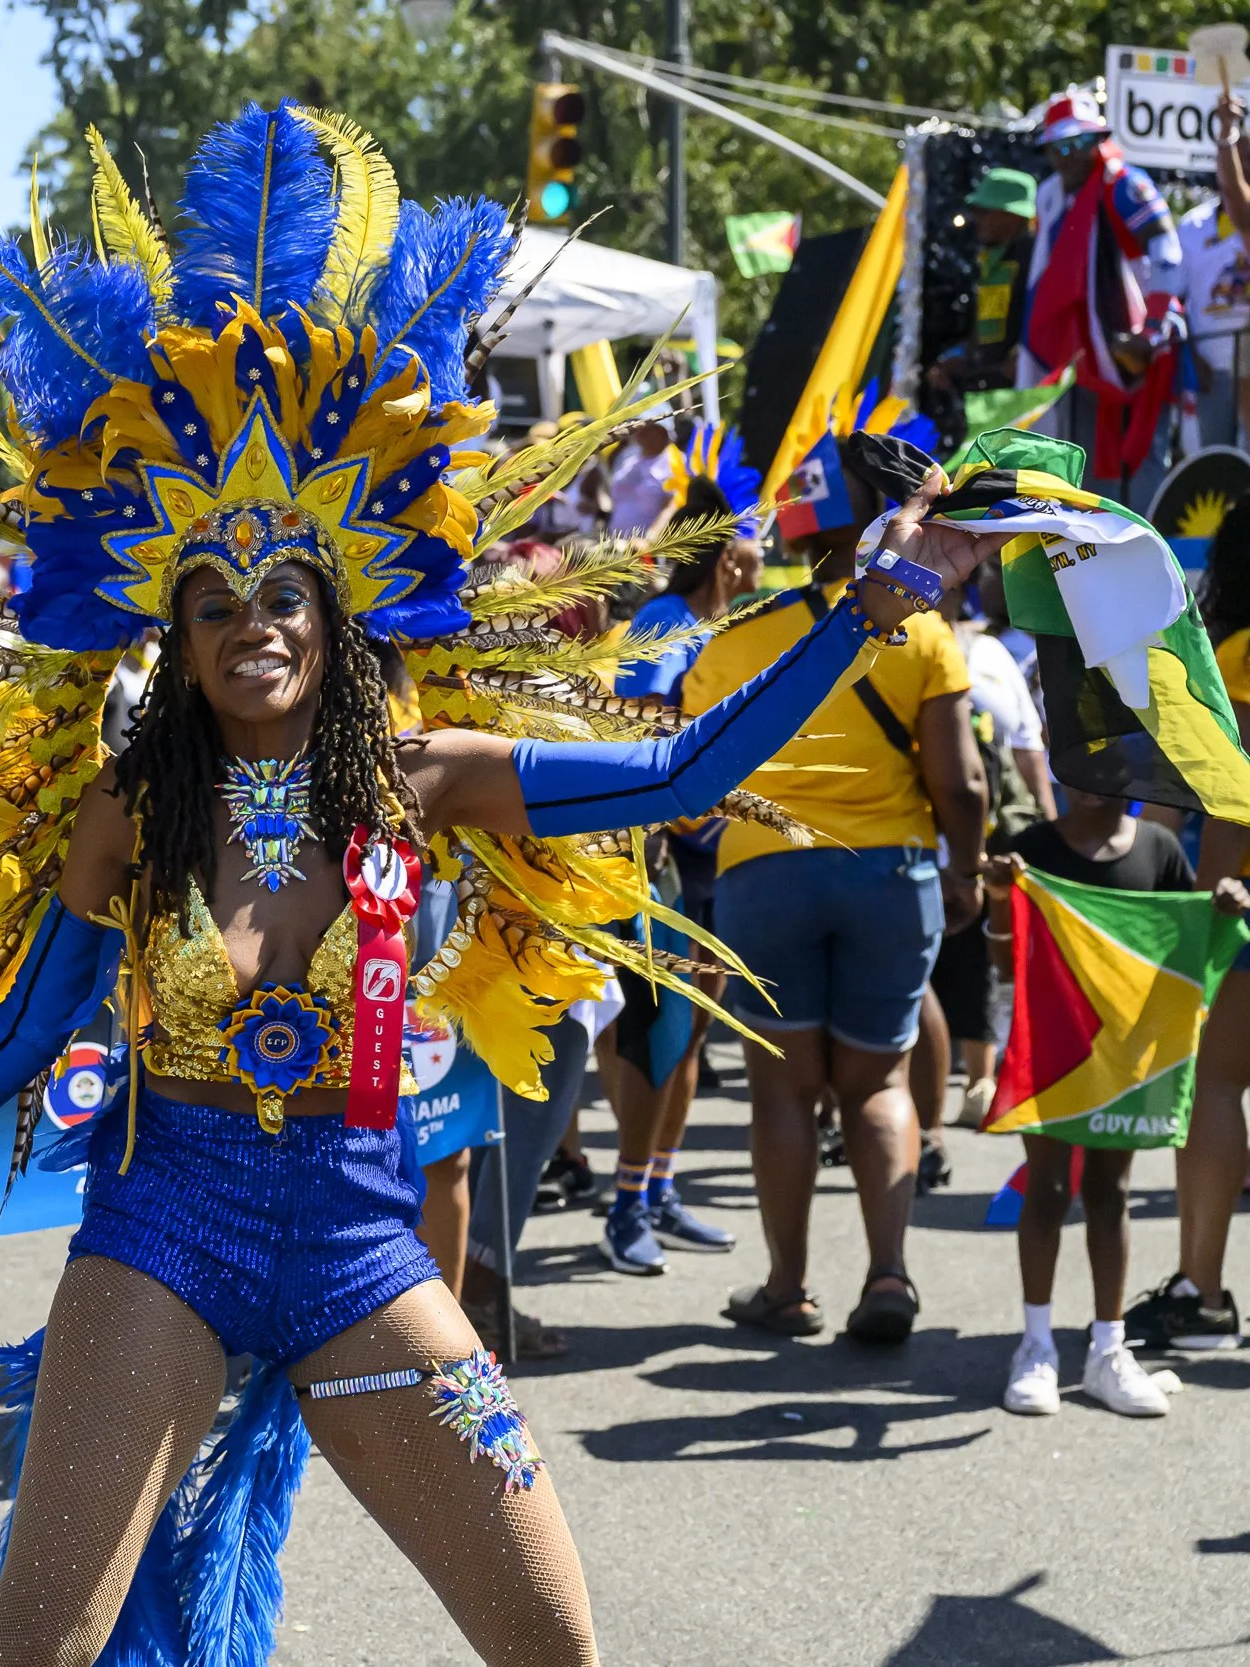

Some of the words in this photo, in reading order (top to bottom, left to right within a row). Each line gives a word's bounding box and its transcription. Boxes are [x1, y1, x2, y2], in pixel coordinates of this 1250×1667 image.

[1076, 543, 1098, 561] NY
[371, 1008, 385, 1087] GUEST
[417, 1120, 444, 1145] 5TH
